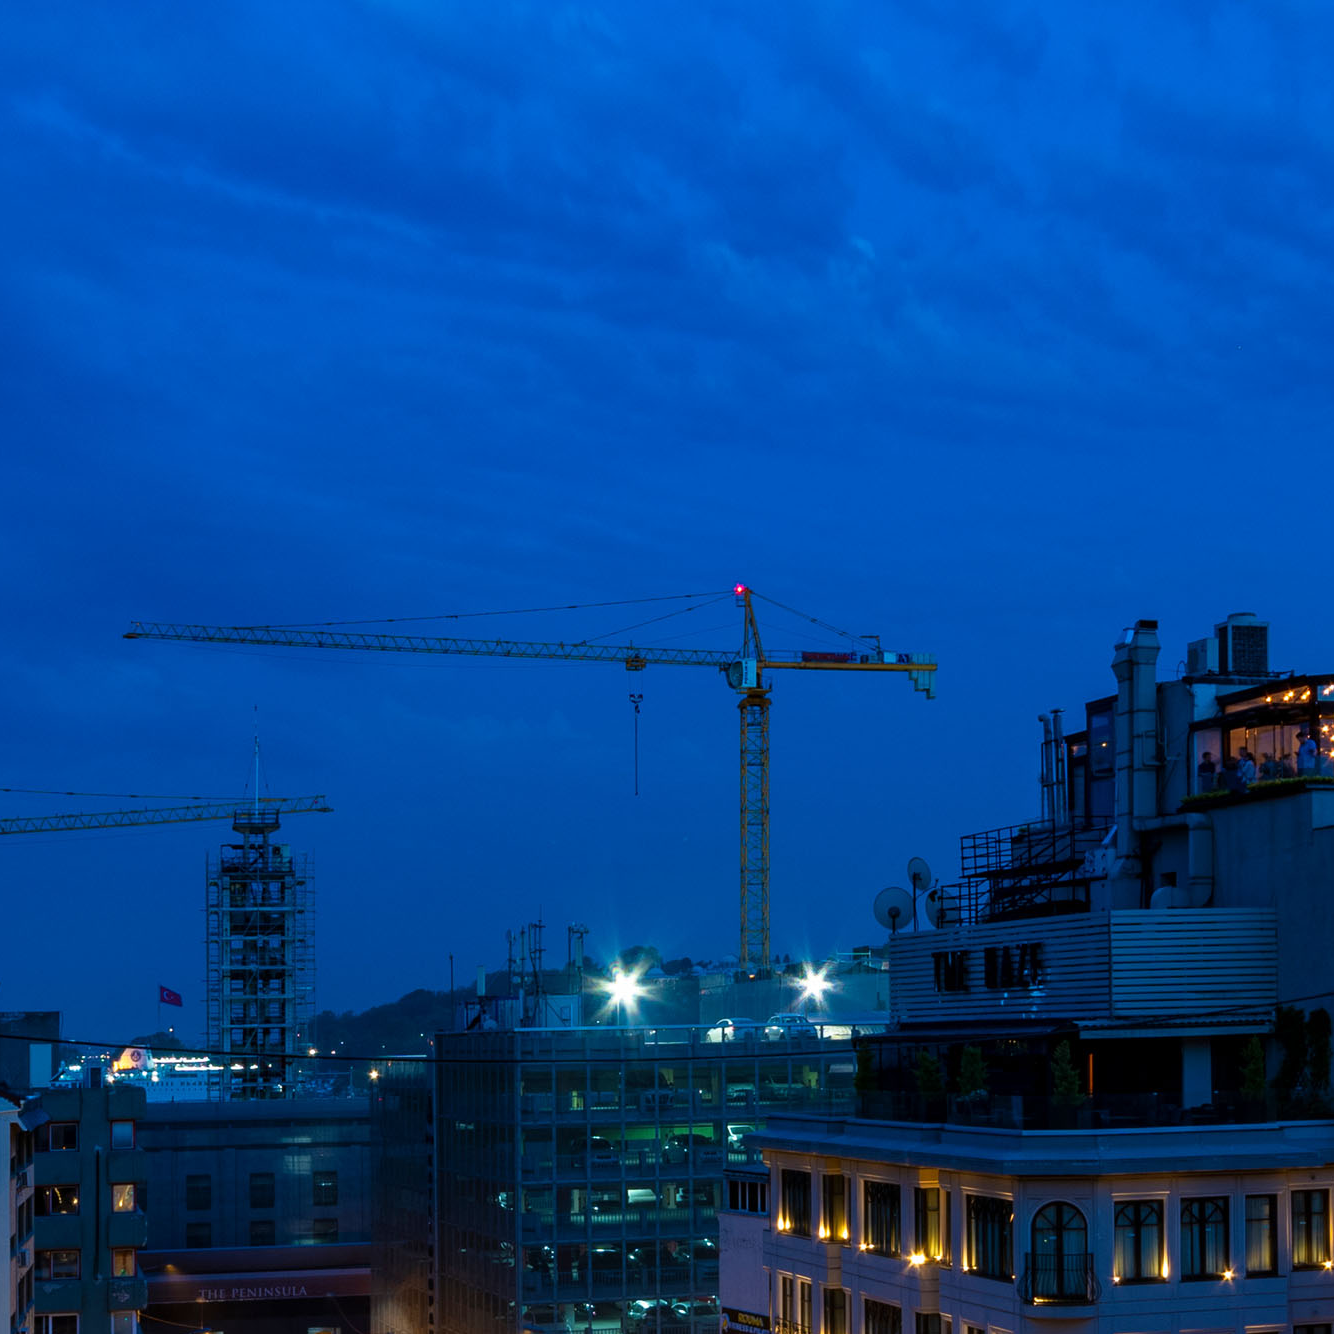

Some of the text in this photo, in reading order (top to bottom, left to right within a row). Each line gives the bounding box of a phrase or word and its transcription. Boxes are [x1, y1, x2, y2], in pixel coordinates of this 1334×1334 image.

[931, 950, 969, 992] THE
[199, 1286, 307, 1299] THE PENINSULA
